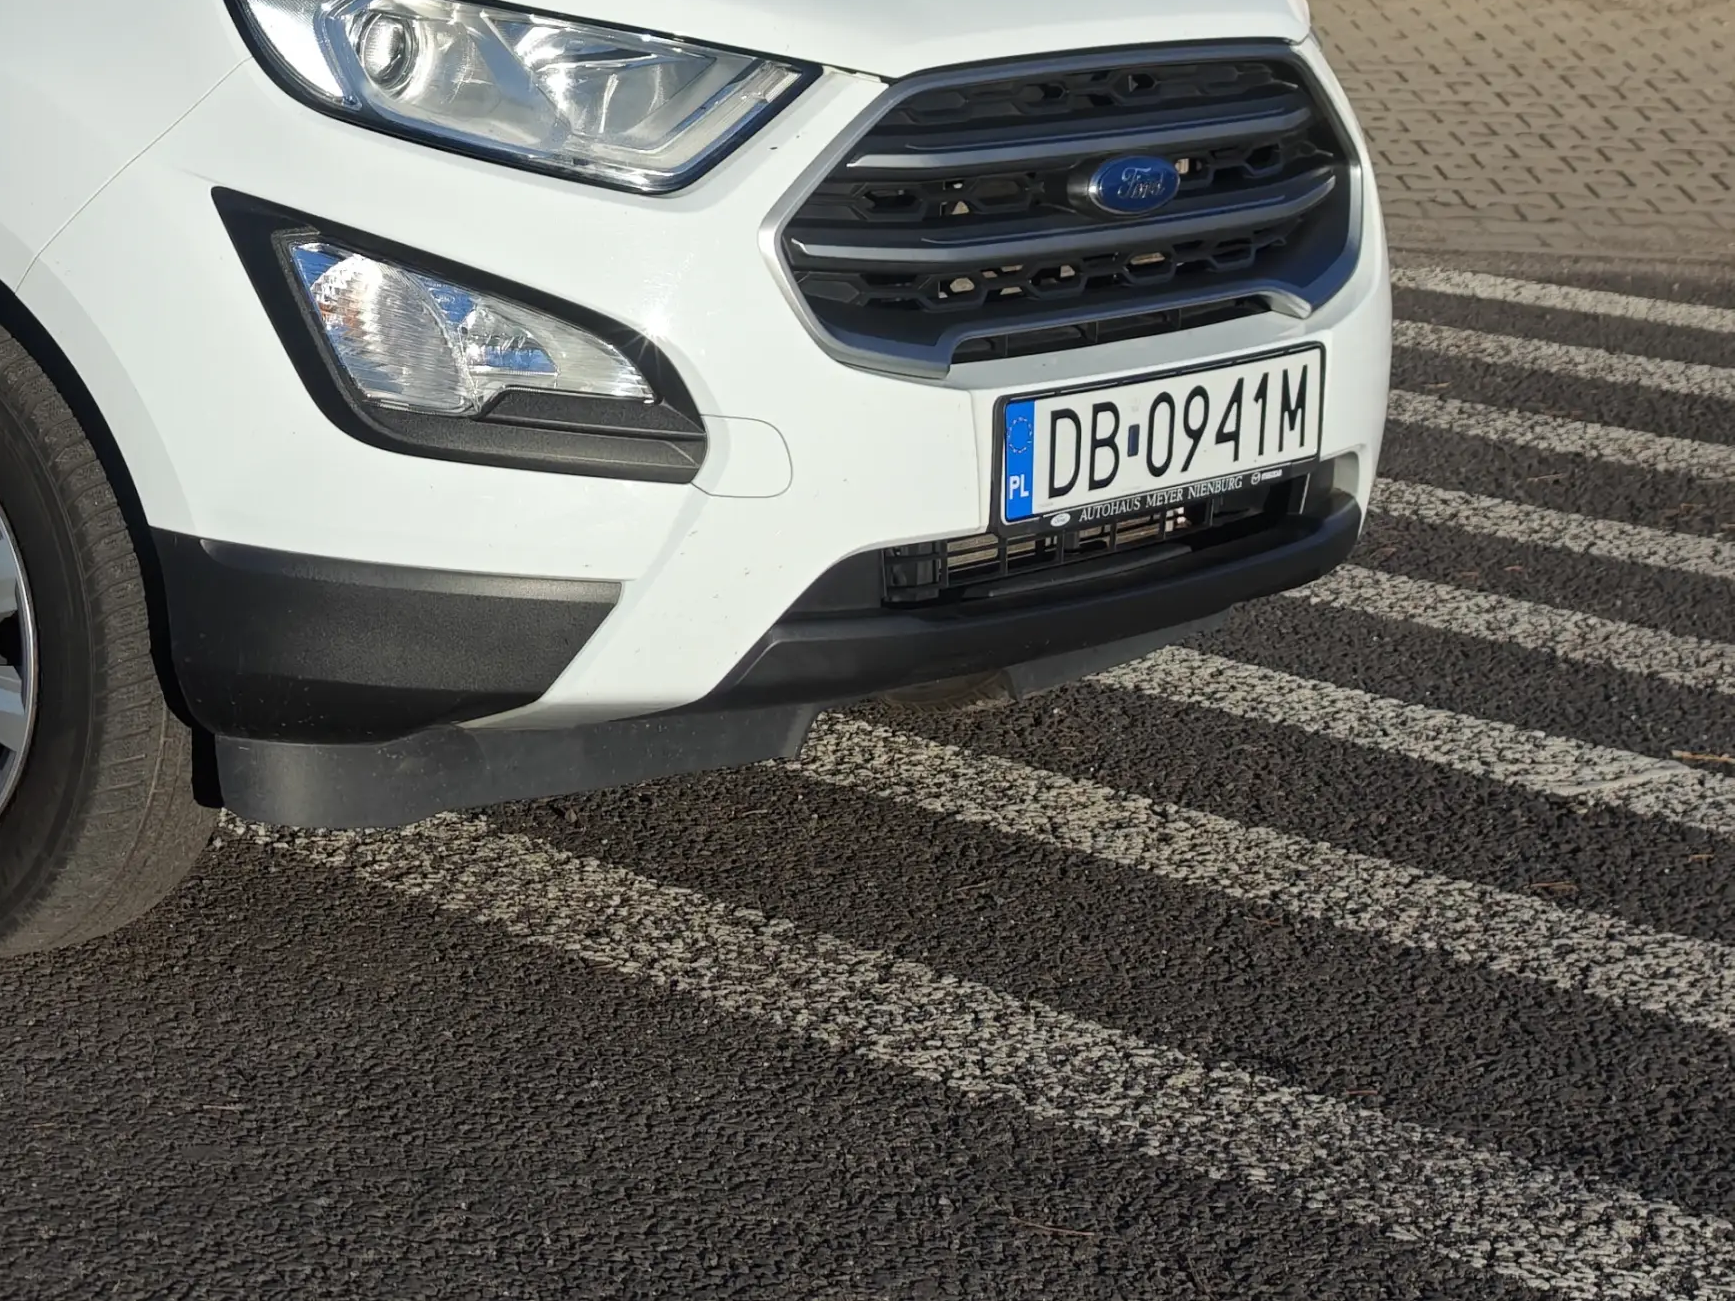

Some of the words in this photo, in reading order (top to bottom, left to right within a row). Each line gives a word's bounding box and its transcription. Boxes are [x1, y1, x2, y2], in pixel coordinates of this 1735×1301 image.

[1047, 401, 1121, 499] DB
[1145, 364, 1308, 478] 0941M
[1008, 474, 1030, 501] PL
[1079, 496, 1141, 523] AUTOHAUS
[1145, 488, 1184, 509] MEYER
[1187, 476, 1243, 500] NIENBURG
